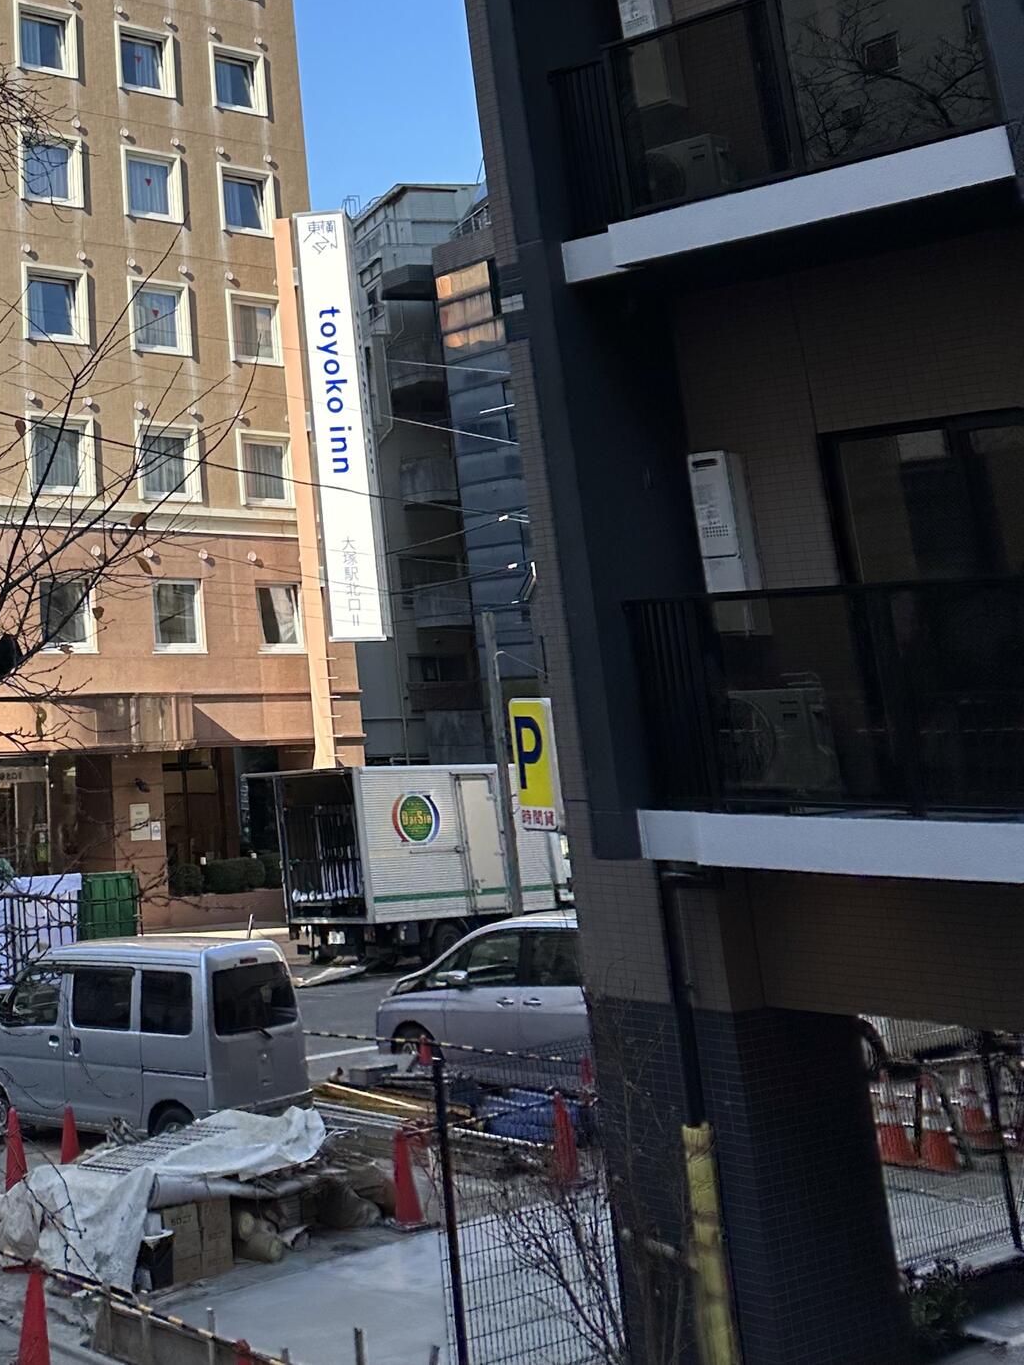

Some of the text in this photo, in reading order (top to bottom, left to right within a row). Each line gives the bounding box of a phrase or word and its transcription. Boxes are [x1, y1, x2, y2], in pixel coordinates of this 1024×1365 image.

[315, 306, 352, 474] toyoko inn
[513, 715, 543, 790] P
[521, 809, 555, 827] 時間貸
